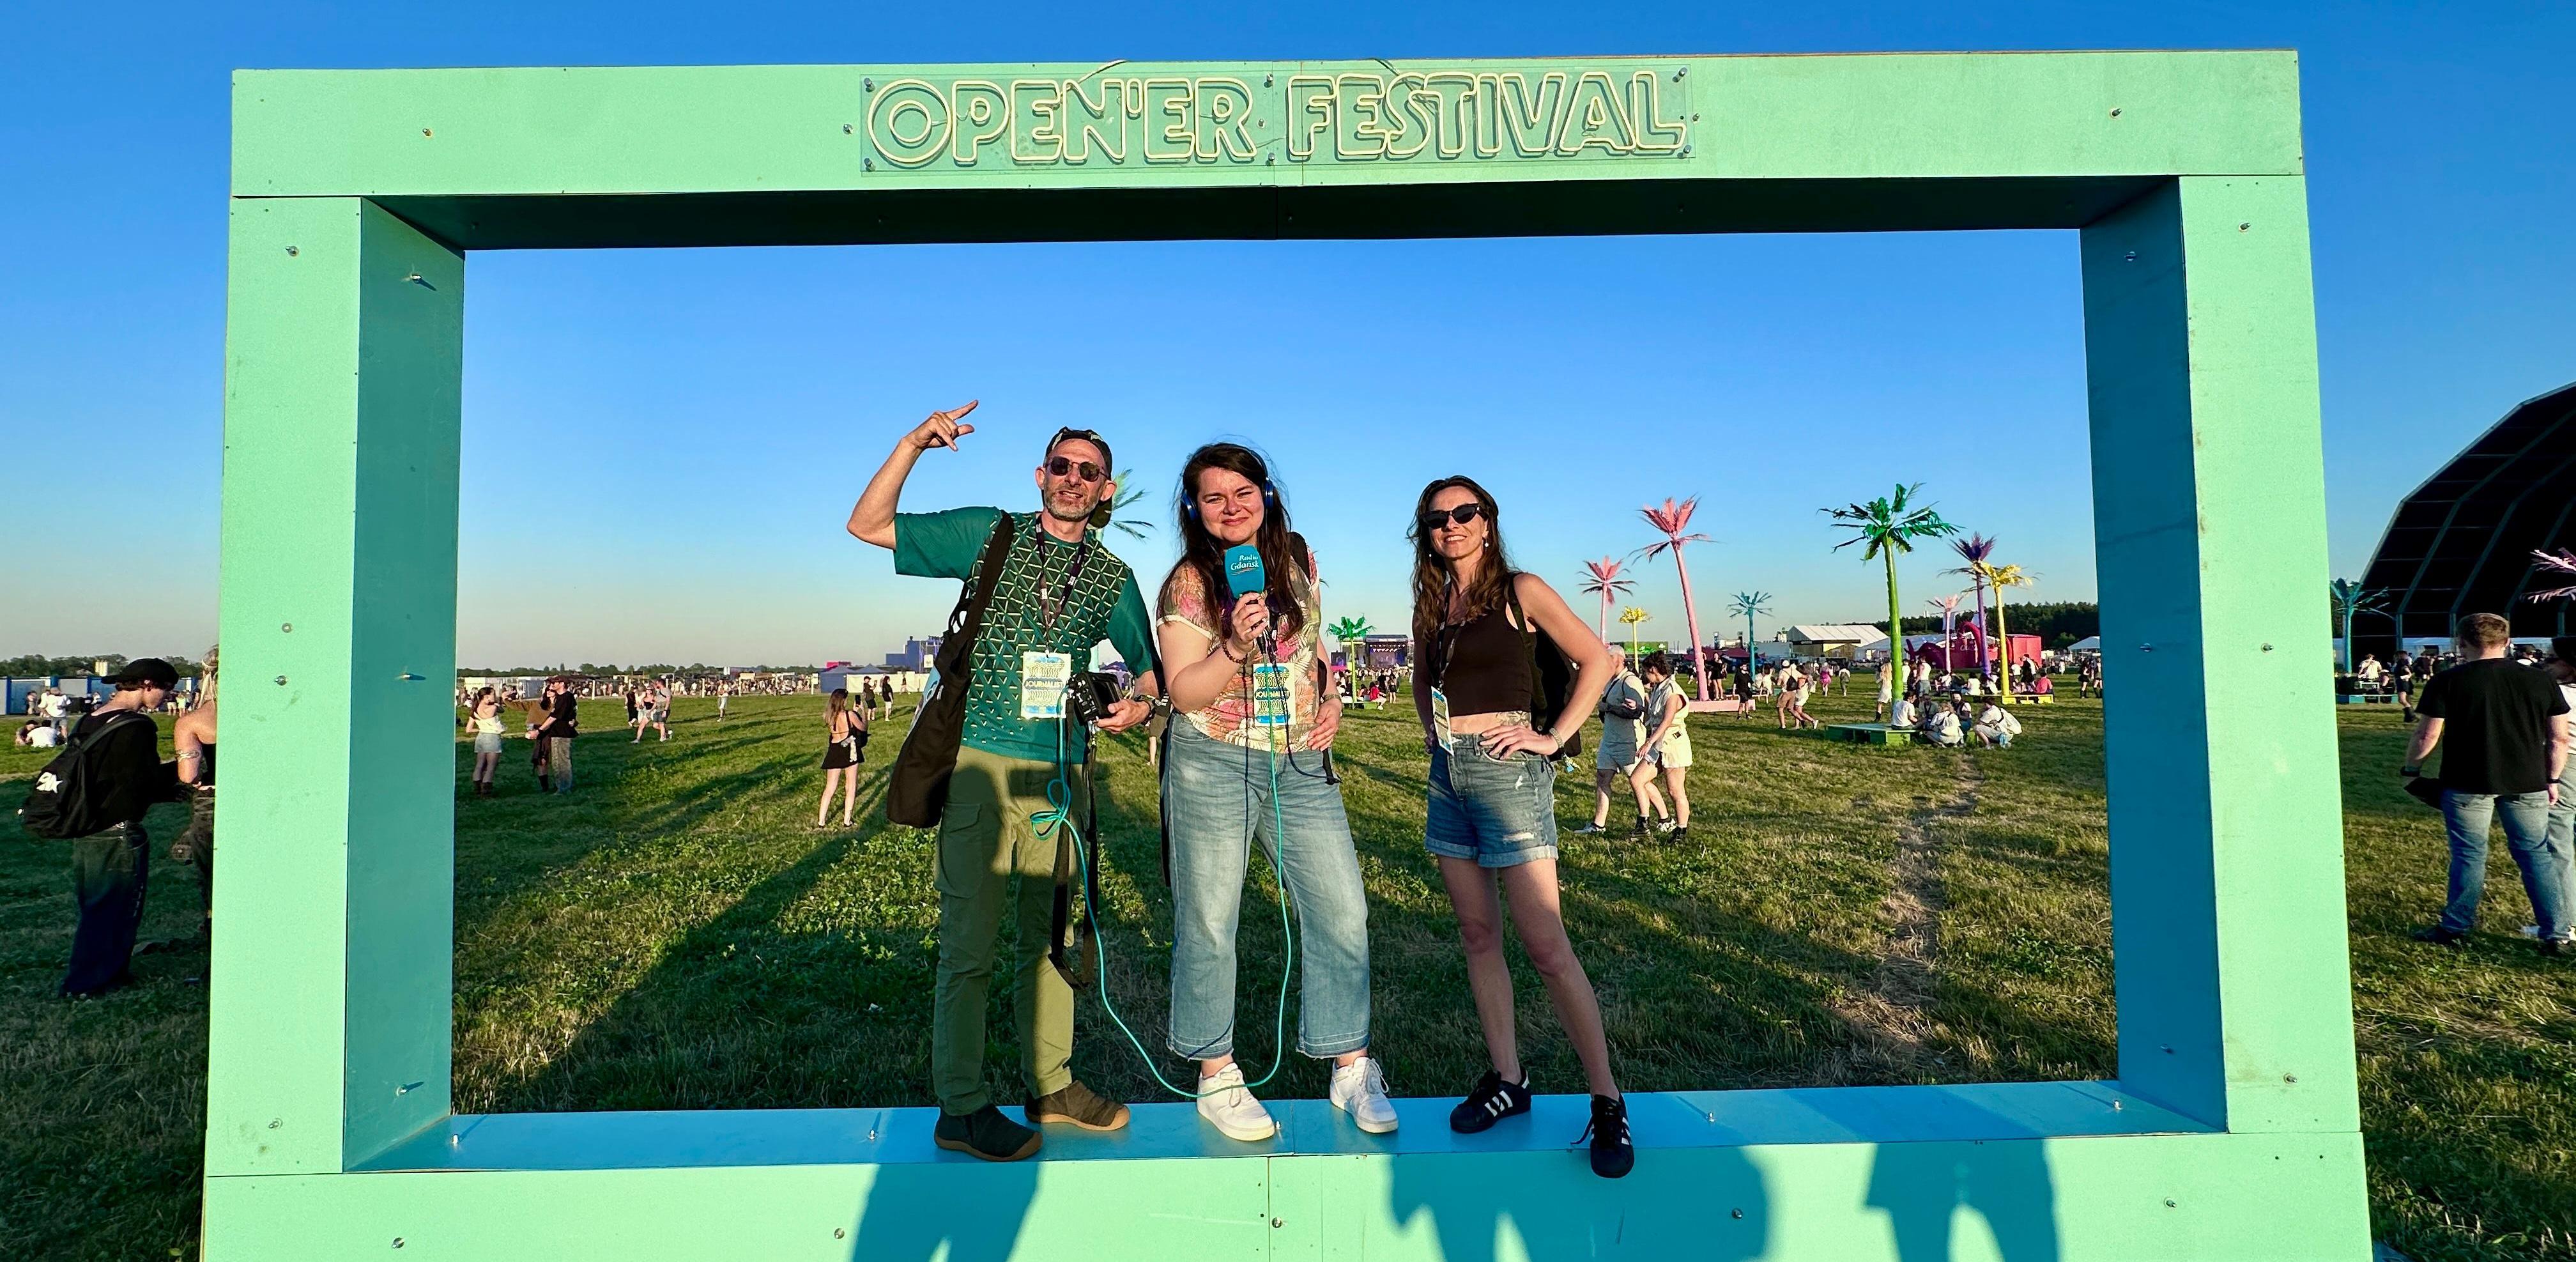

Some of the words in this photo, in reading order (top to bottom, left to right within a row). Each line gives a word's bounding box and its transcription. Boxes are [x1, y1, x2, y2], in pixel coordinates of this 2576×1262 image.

[868, 77, 1257, 164] OPEN'ER
[1287, 72, 1687, 155] FESTIVAL
[1230, 560, 1259, 570] Gdańsk
